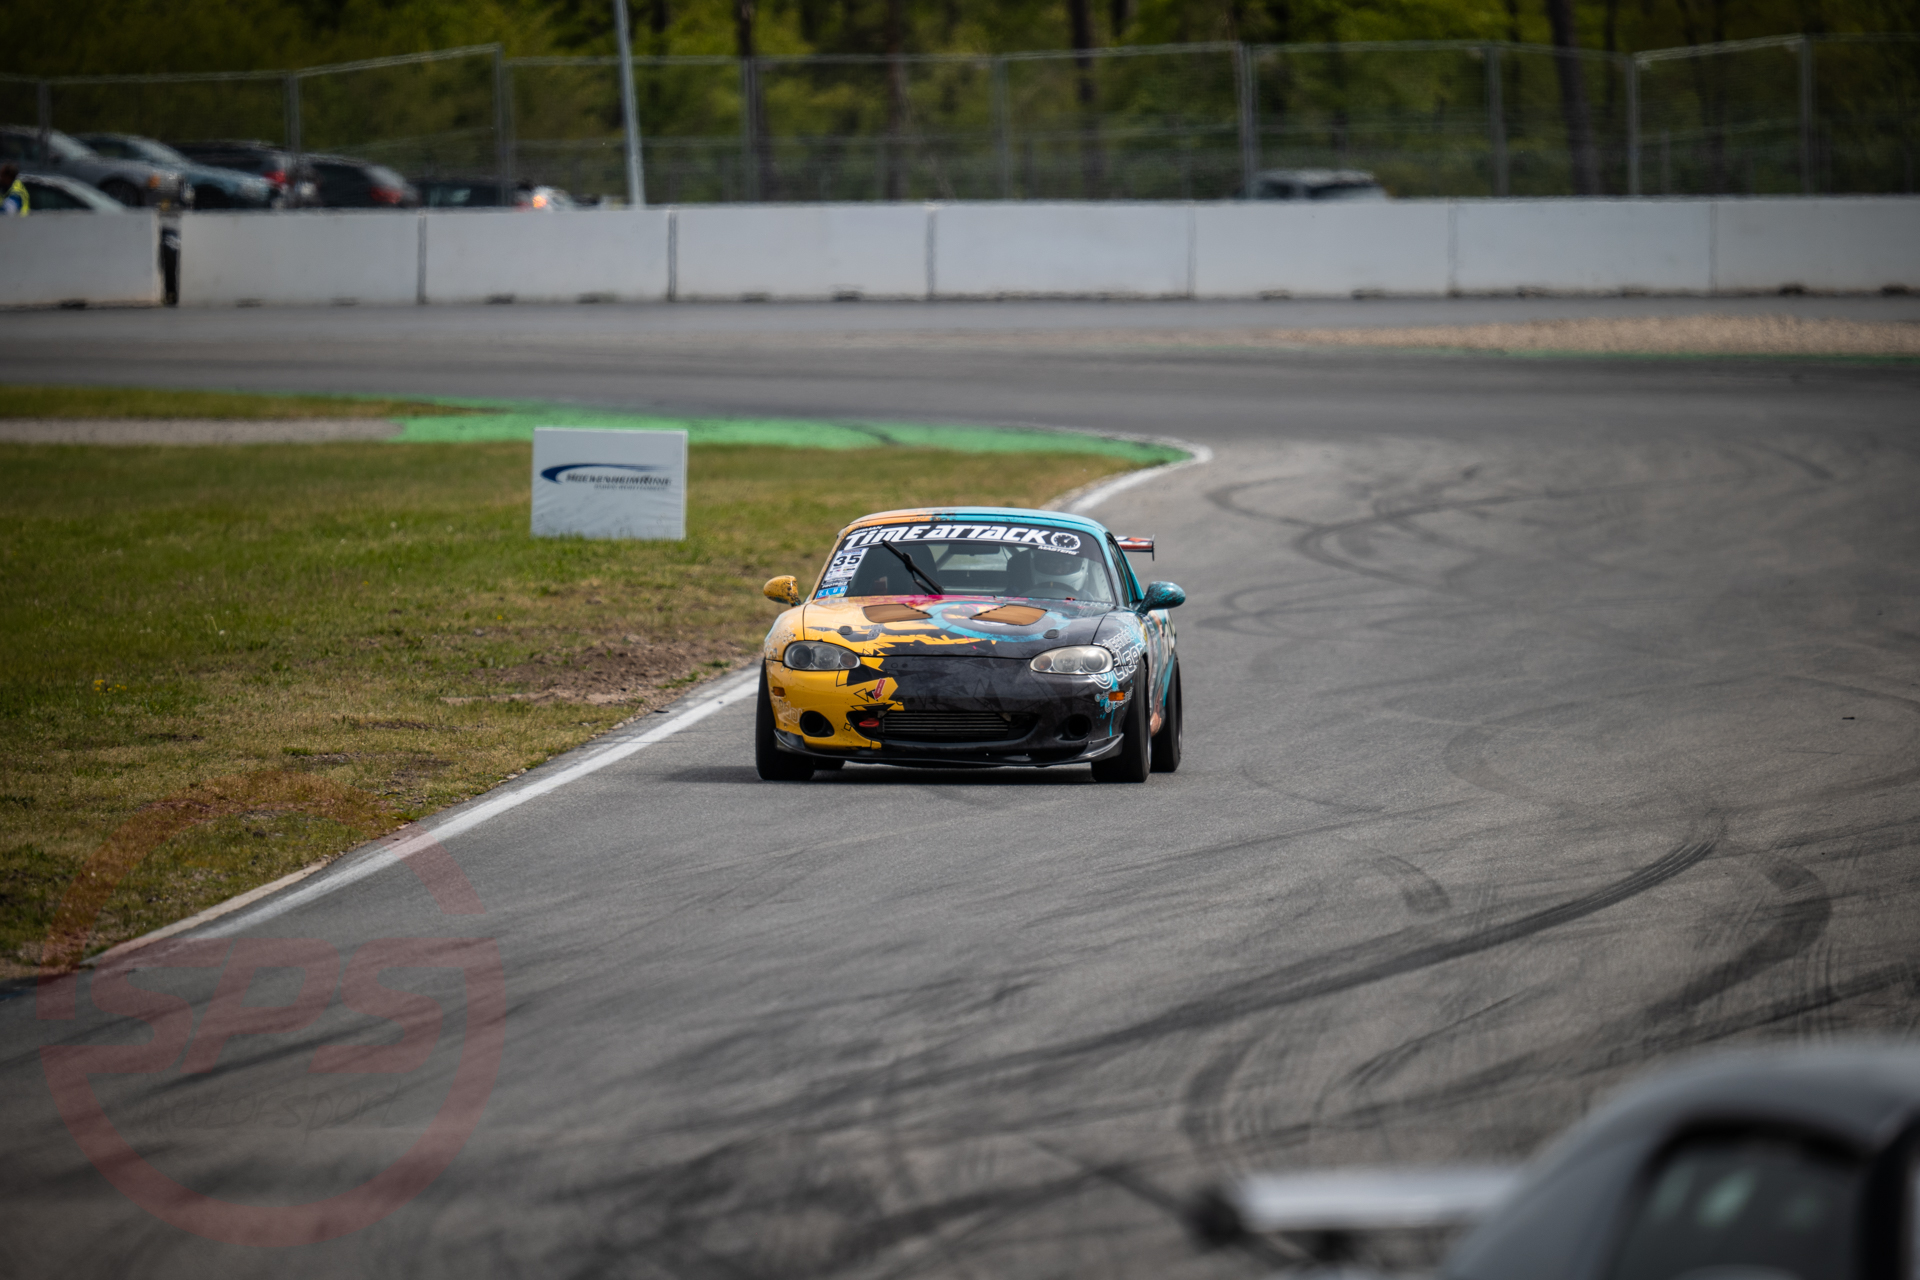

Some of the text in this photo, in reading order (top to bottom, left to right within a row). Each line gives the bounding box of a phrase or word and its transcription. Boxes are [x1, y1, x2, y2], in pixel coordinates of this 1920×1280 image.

[922, 525, 1050, 544] ATTACK
[1038, 545, 1079, 555] MASTERS
[833, 554, 861, 567] 35
